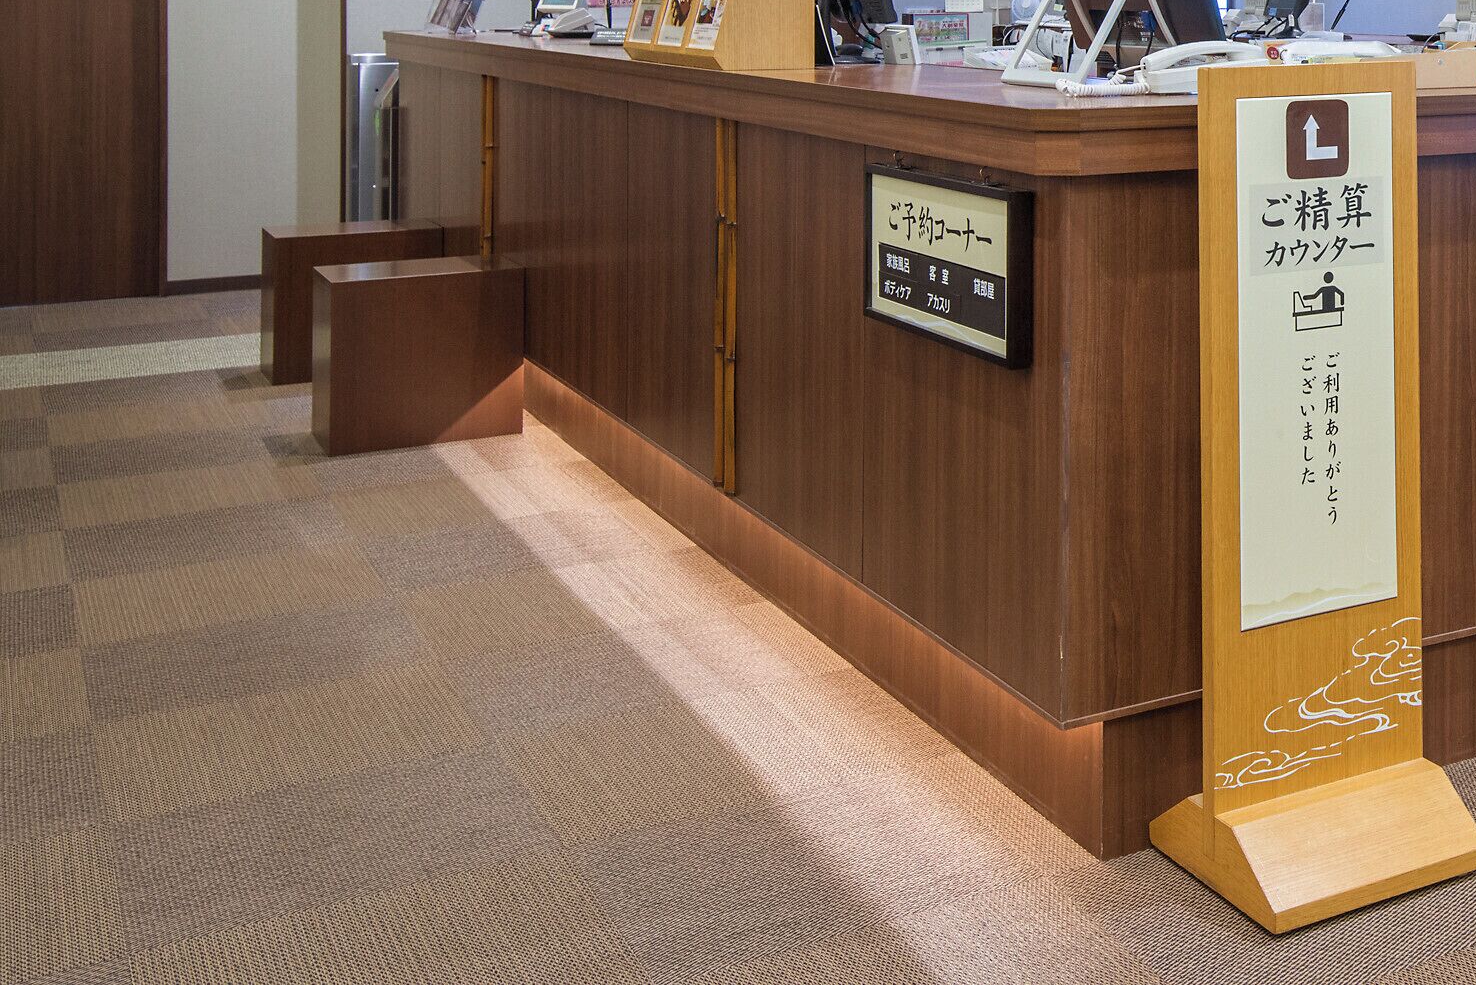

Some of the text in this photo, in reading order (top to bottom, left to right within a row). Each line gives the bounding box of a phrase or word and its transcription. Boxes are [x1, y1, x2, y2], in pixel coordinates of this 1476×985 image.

[889, 202, 992, 252] ご予約コーナー
[1262, 183, 1372, 232] ご精算
[886, 253, 910, 274] 家族風呂
[1264, 235, 1375, 267] カウンター
[927, 292, 951, 314] アカスリ
[973, 277, 995, 300] 貸部屋
[1300, 355, 1317, 485] ございました
[1323, 352, 1342, 525] ご利用ありがとう
